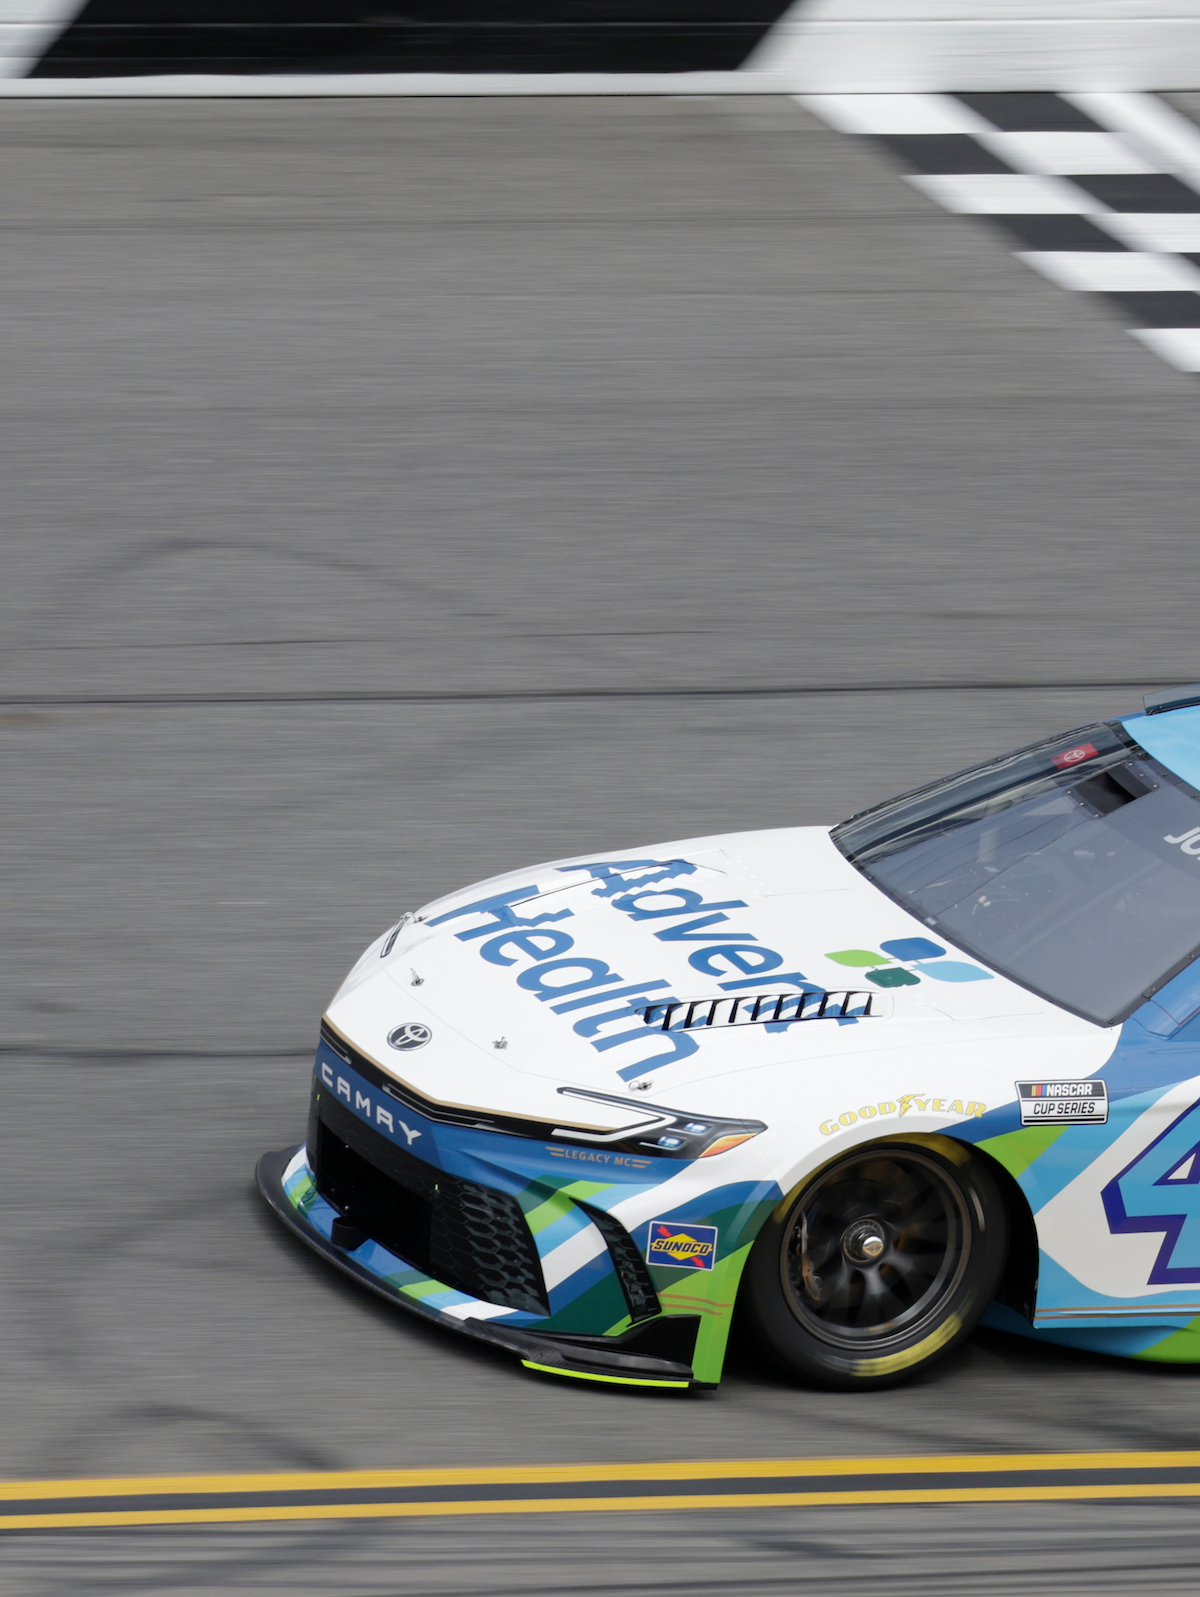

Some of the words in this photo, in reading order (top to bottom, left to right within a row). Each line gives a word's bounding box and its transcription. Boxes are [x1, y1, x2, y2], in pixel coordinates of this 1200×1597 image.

[553, 858, 867, 1034] Advent
[424, 885, 708, 1083] Health
[322, 1062, 422, 1146] CAMRY
[1046, 1083, 1093, 1097] NASCAR
[819, 1094, 987, 1136] GOODYEAR
[1033, 1102, 1055, 1115] CUP
[1057, 1101, 1096, 1115] SERIES
[565, 1150, 611, 1164] LEGACY
[614, 1156, 633, 1167] MC
[654, 1239, 711, 1254] SUNOCO
